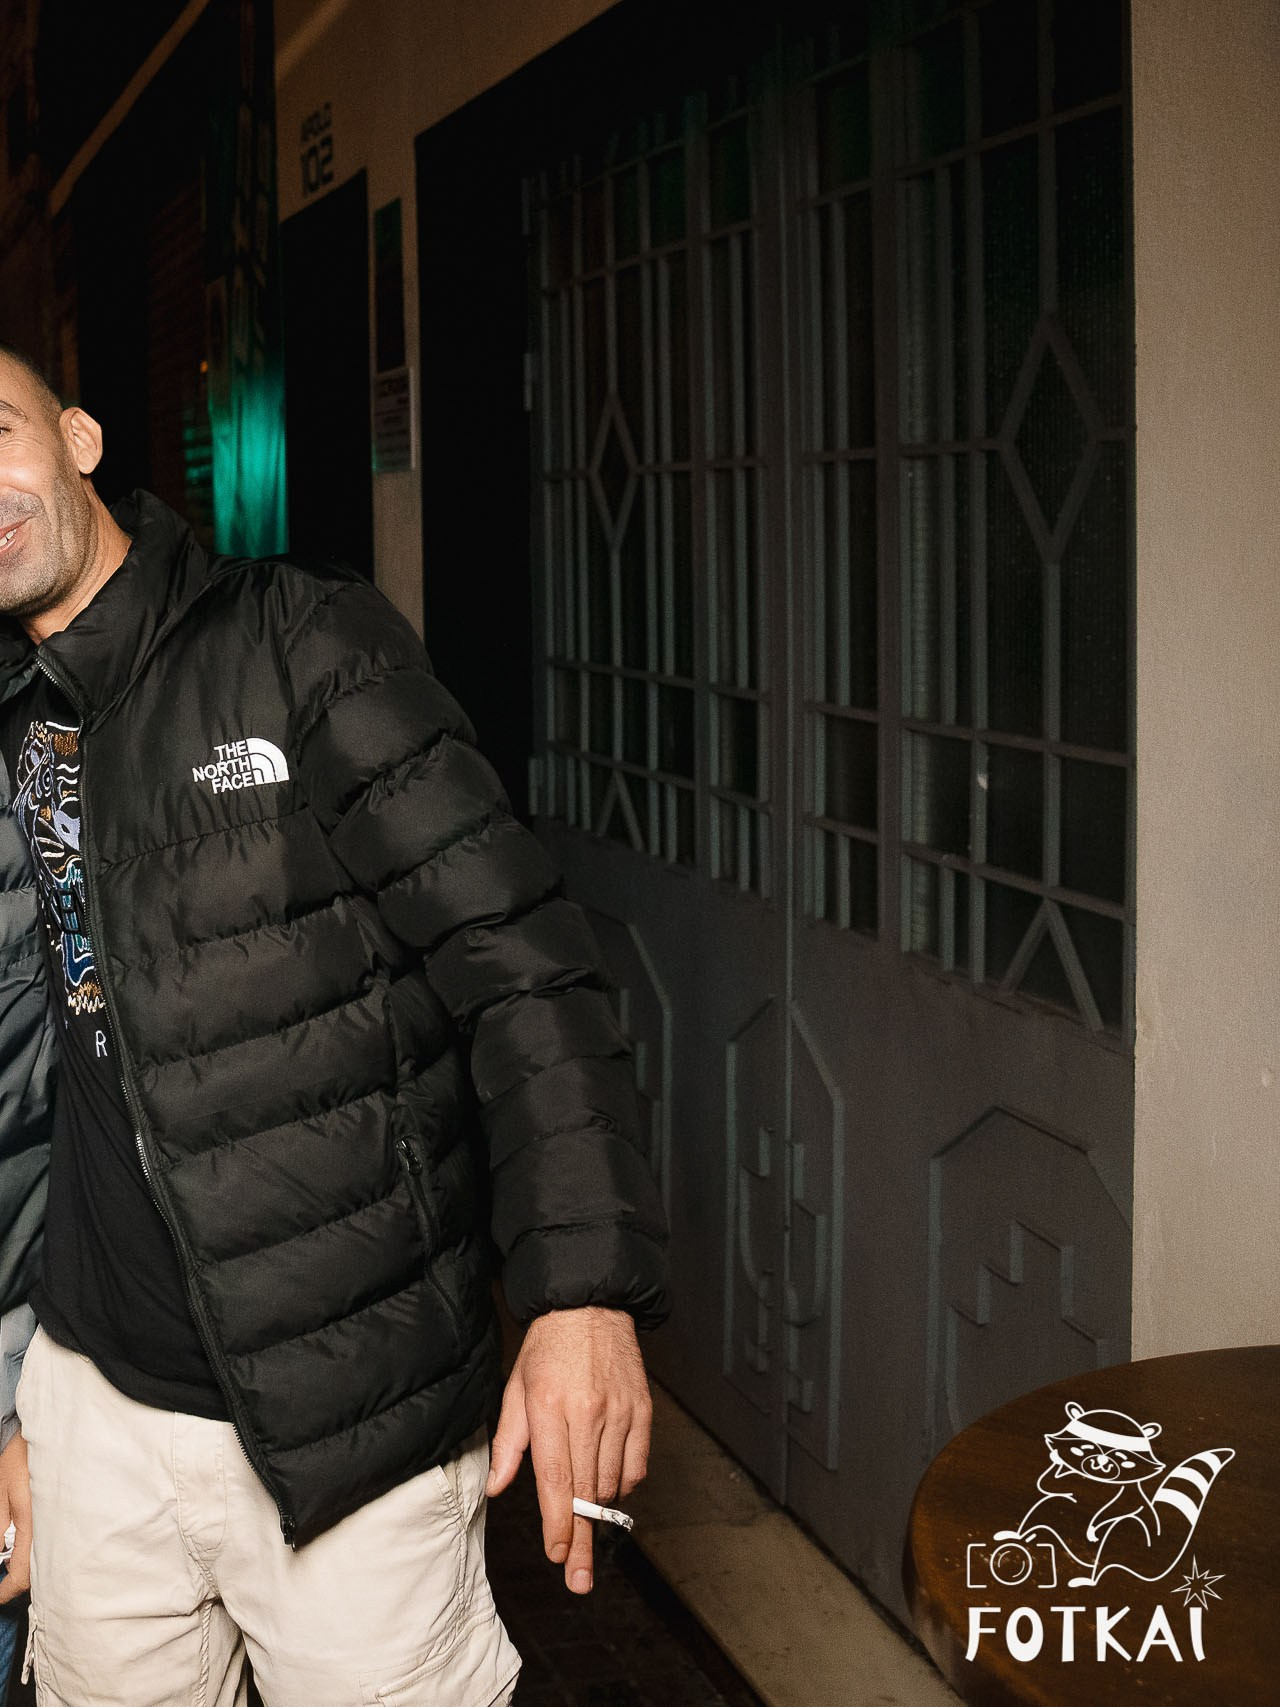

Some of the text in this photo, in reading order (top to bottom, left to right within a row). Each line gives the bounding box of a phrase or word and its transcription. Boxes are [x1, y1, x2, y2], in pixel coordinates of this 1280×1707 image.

[300, 134, 334, 198] 102
[213, 740, 249, 762] THE
[191, 755, 251, 782] NORTH
[211, 771, 255, 794] FACE
